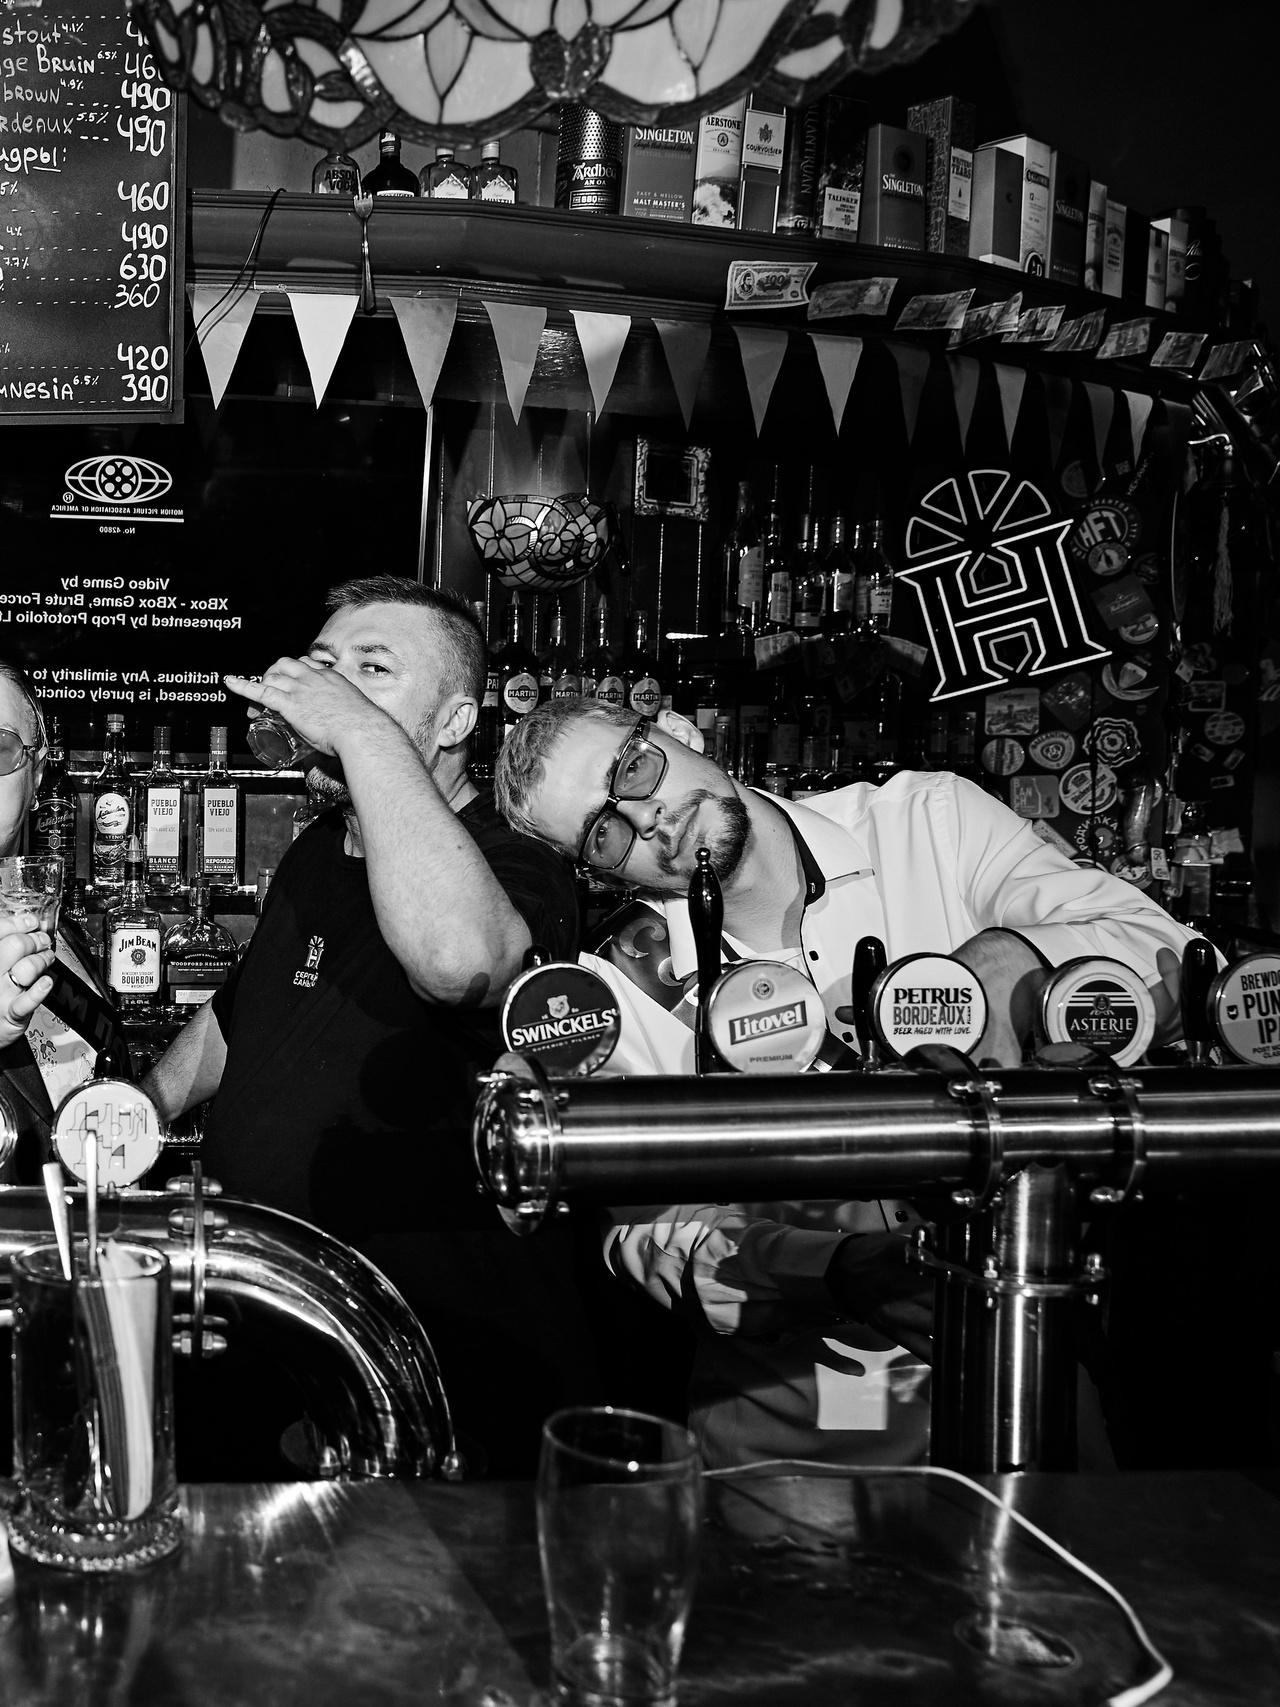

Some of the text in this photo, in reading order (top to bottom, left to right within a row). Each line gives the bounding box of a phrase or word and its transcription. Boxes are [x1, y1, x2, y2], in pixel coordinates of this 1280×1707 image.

[2, 21, 62, 43] stout
[36, 44, 96, 74] Bruin
[4, 82, 61, 104] brown
[121, 77, 171, 112] 490
[705, 116, 742, 131] AERSTONE
[117, 115, 166, 156] 490
[635, 126, 694, 144] SINGLETON
[118, 181, 169, 212] 460
[882, 174, 925, 198] SINGLETON
[121, 221, 168, 249] 490
[120, 253, 167, 281] 630
[115, 284, 160, 308] 360
[117, 343, 169, 371] 420
[121, 375, 169, 402] 390
[150, 799, 178, 808] PUEBLO
[153, 807, 174, 816] VIEJO
[207, 799, 235, 808] PUEBLO
[209, 808, 231, 817] VIEJO
[119, 935, 158, 953] JIM BEAM
[121, 975, 155, 985] BOURBON
[893, 987, 973, 1008] PETRUS
[1243, 988, 1280, 1019] PUN
[733, 1005, 803, 1041] Litovel
[893, 1005, 966, 1027] BORDEAUX
[1070, 1018, 1133, 1033] ASTERIE
[893, 1027, 913, 1036] BEER
[934, 1026, 952, 1036] WITH
[748, 1054, 794, 1063] PREMIUM
